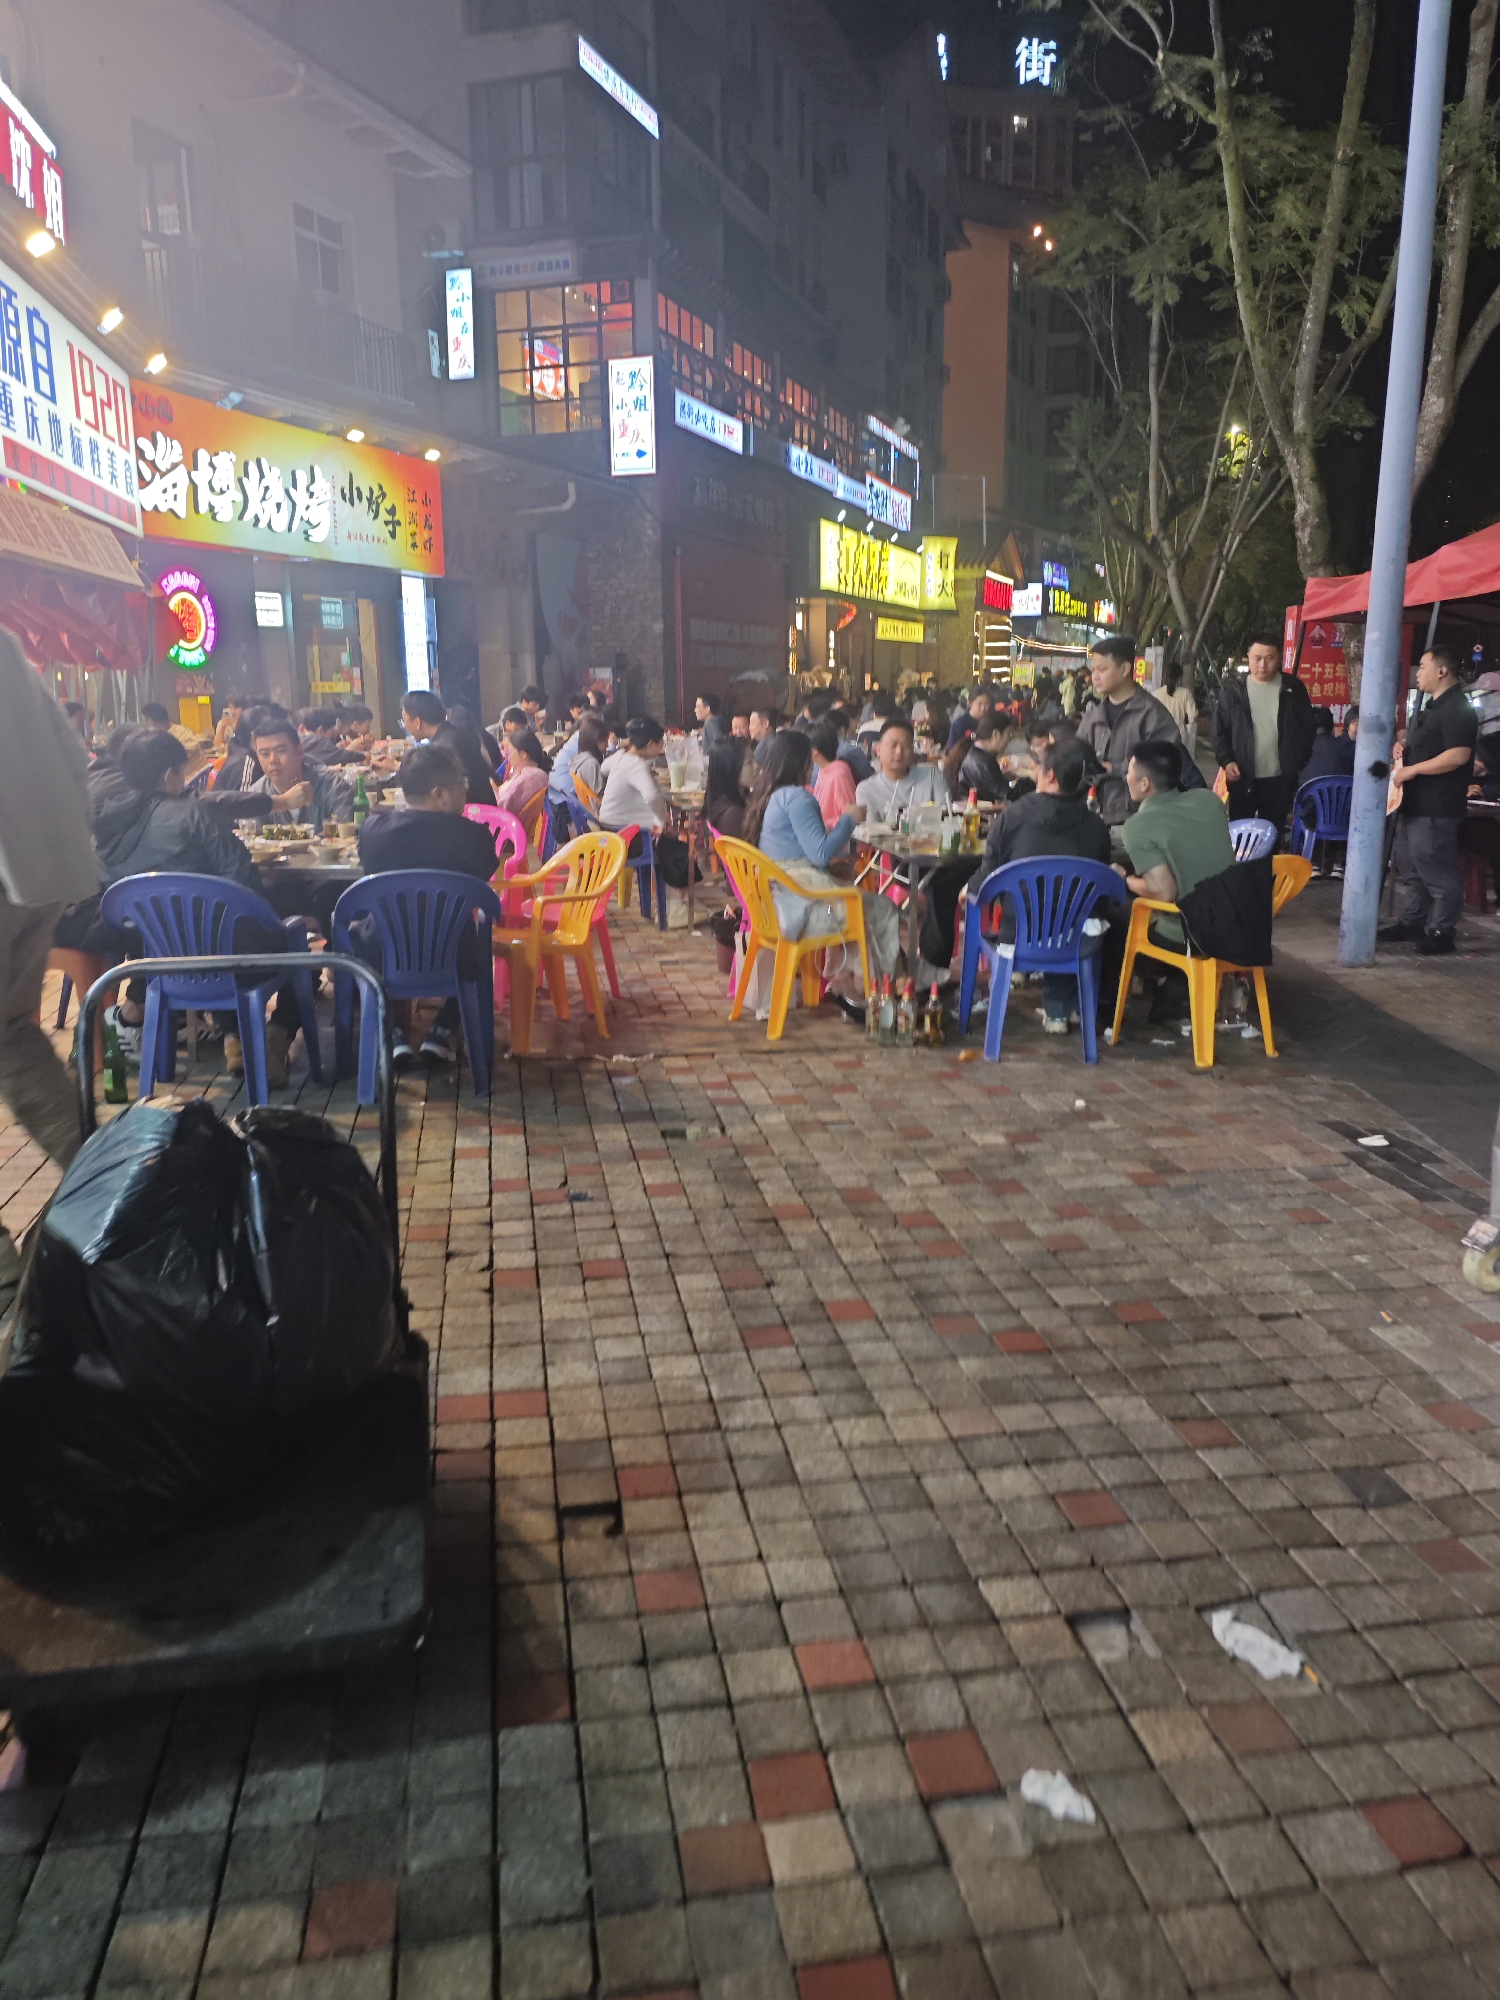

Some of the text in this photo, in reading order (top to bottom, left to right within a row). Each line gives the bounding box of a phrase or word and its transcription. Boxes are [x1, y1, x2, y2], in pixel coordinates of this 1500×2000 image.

[1015, 37, 1057, 86] 街
[66, 339, 130, 454] 1920
[136, 430, 332, 543] 淄博烧烤
[340, 470, 401, 541] 小炉子
[1300, 661, 1347, 680] 二十五年
